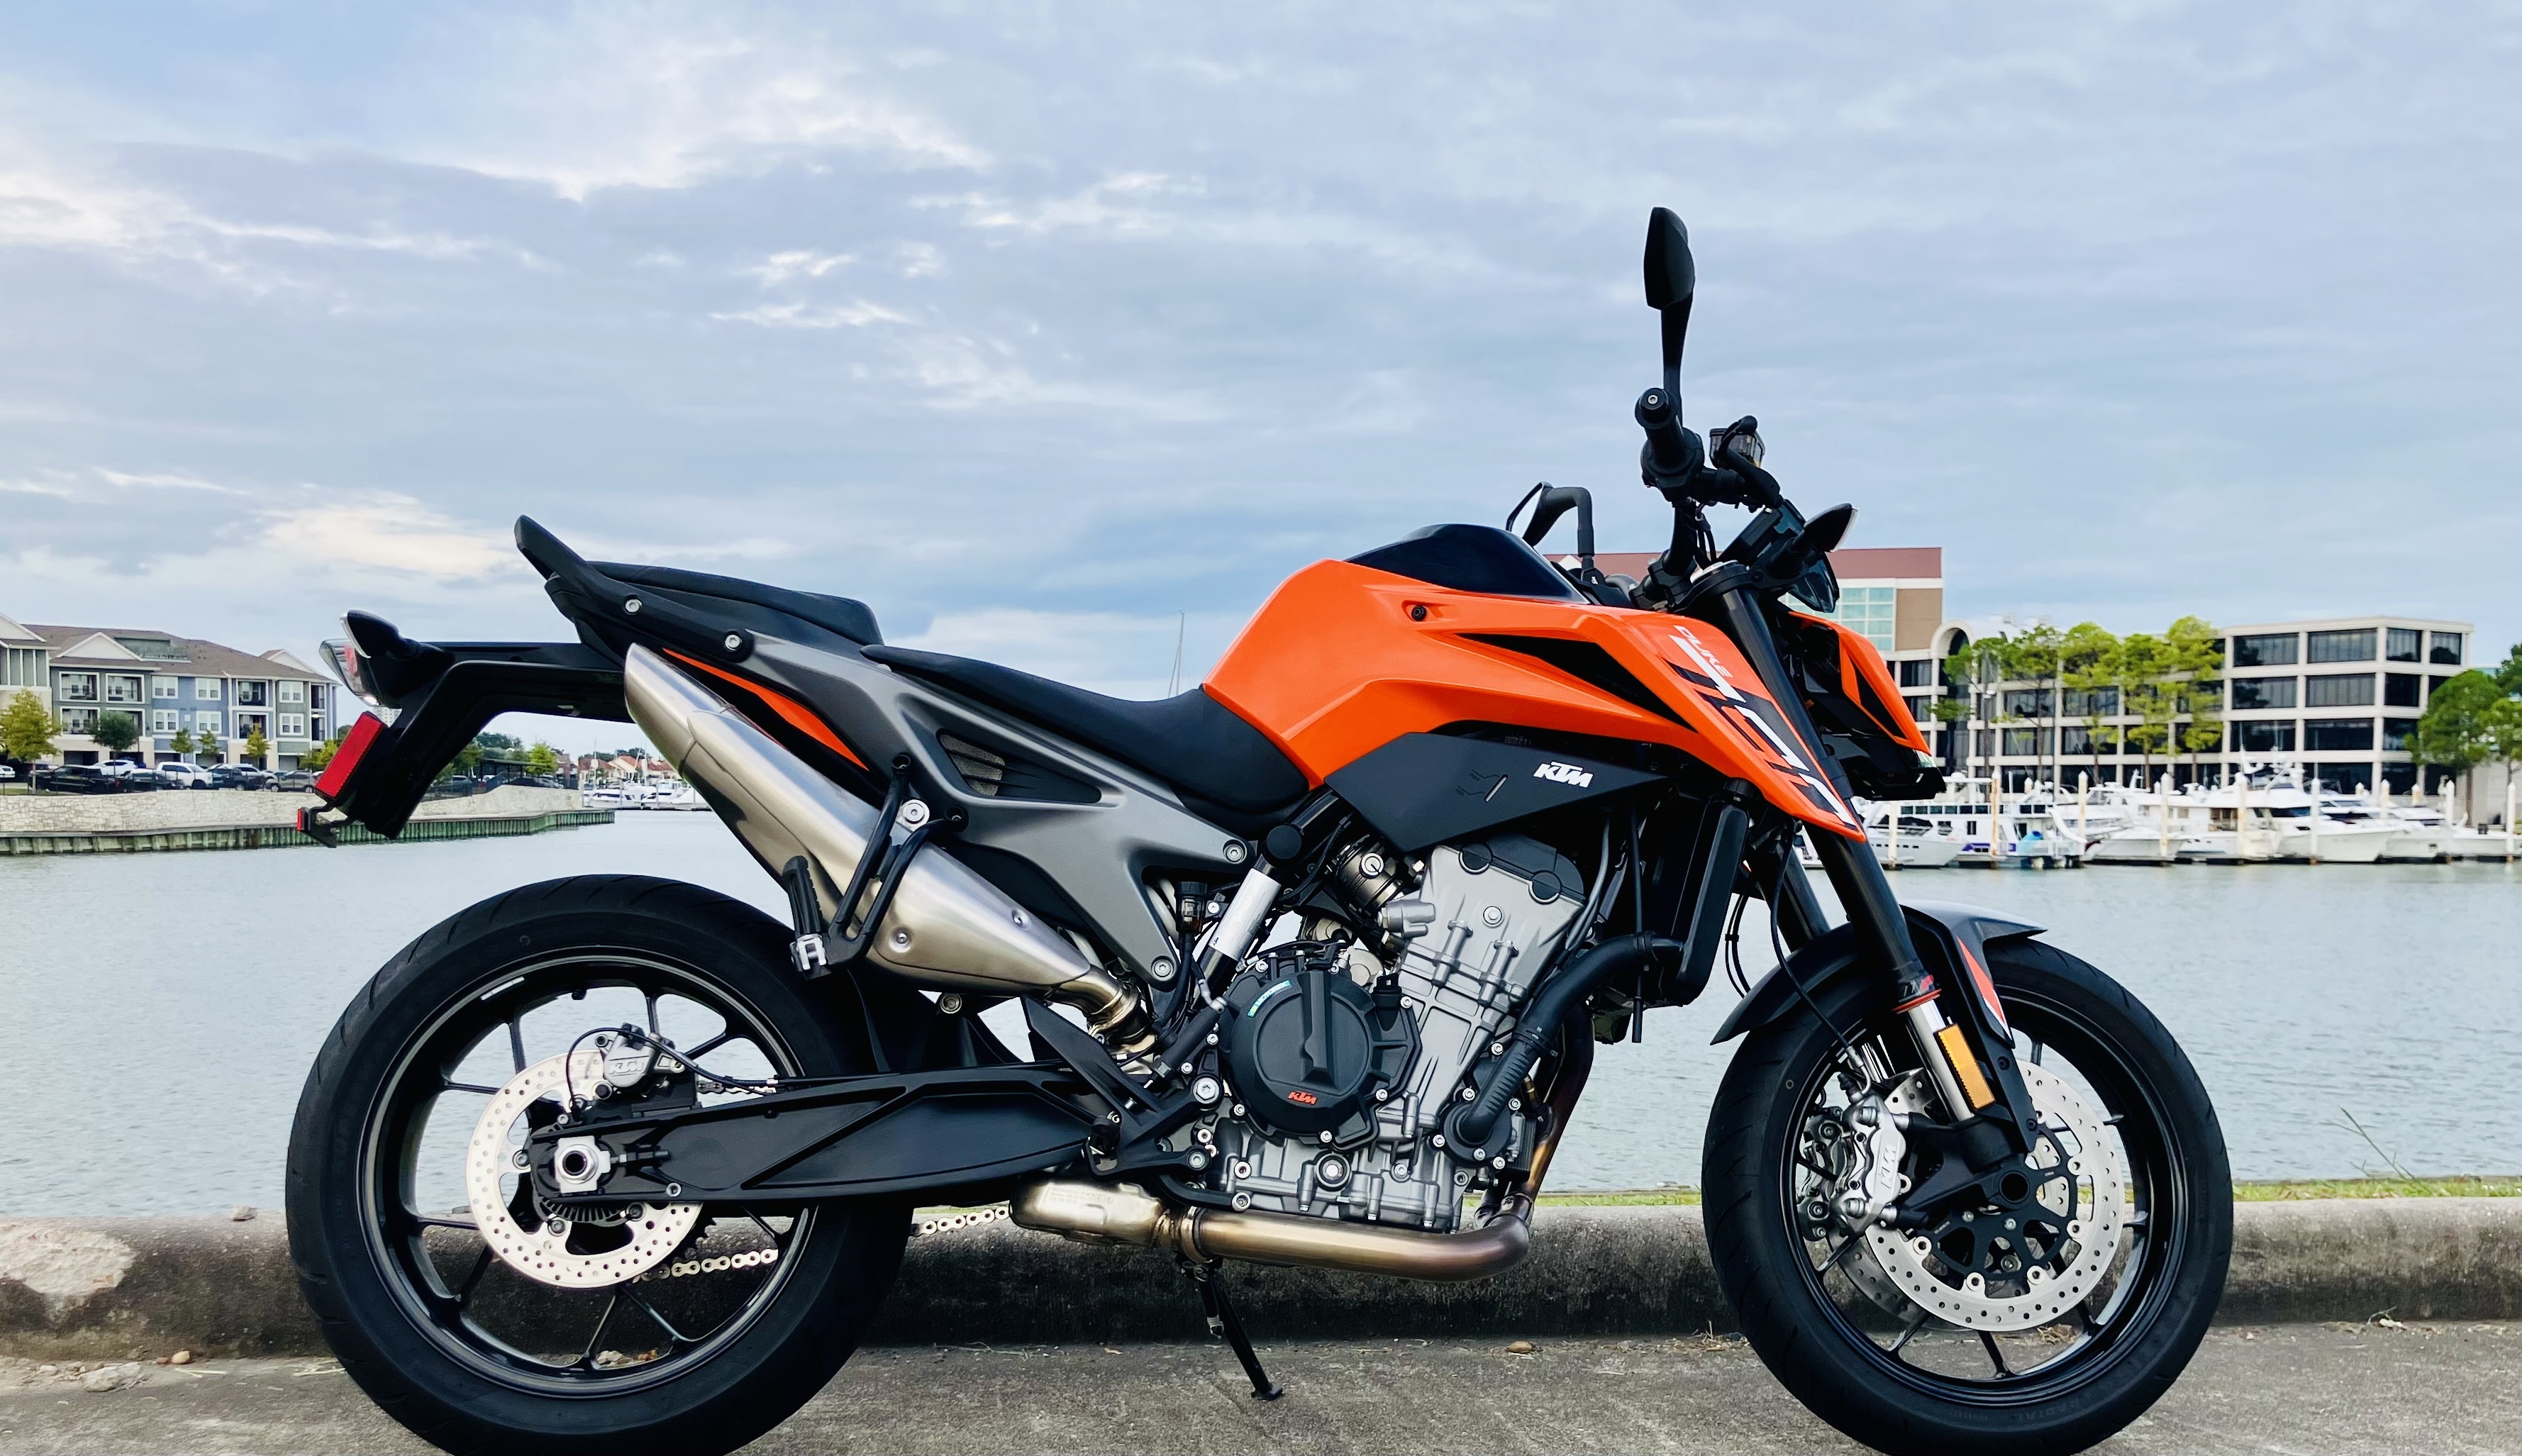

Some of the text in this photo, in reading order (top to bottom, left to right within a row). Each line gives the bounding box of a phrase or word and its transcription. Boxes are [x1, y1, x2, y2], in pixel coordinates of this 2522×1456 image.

[1672, 624, 1733, 678] DUKE
[1533, 761, 1594, 788] KTM
[608, 1060, 644, 1075] KTM
[1287, 1090, 1317, 1105] KTM
[1878, 1143, 1896, 1189] KTM
